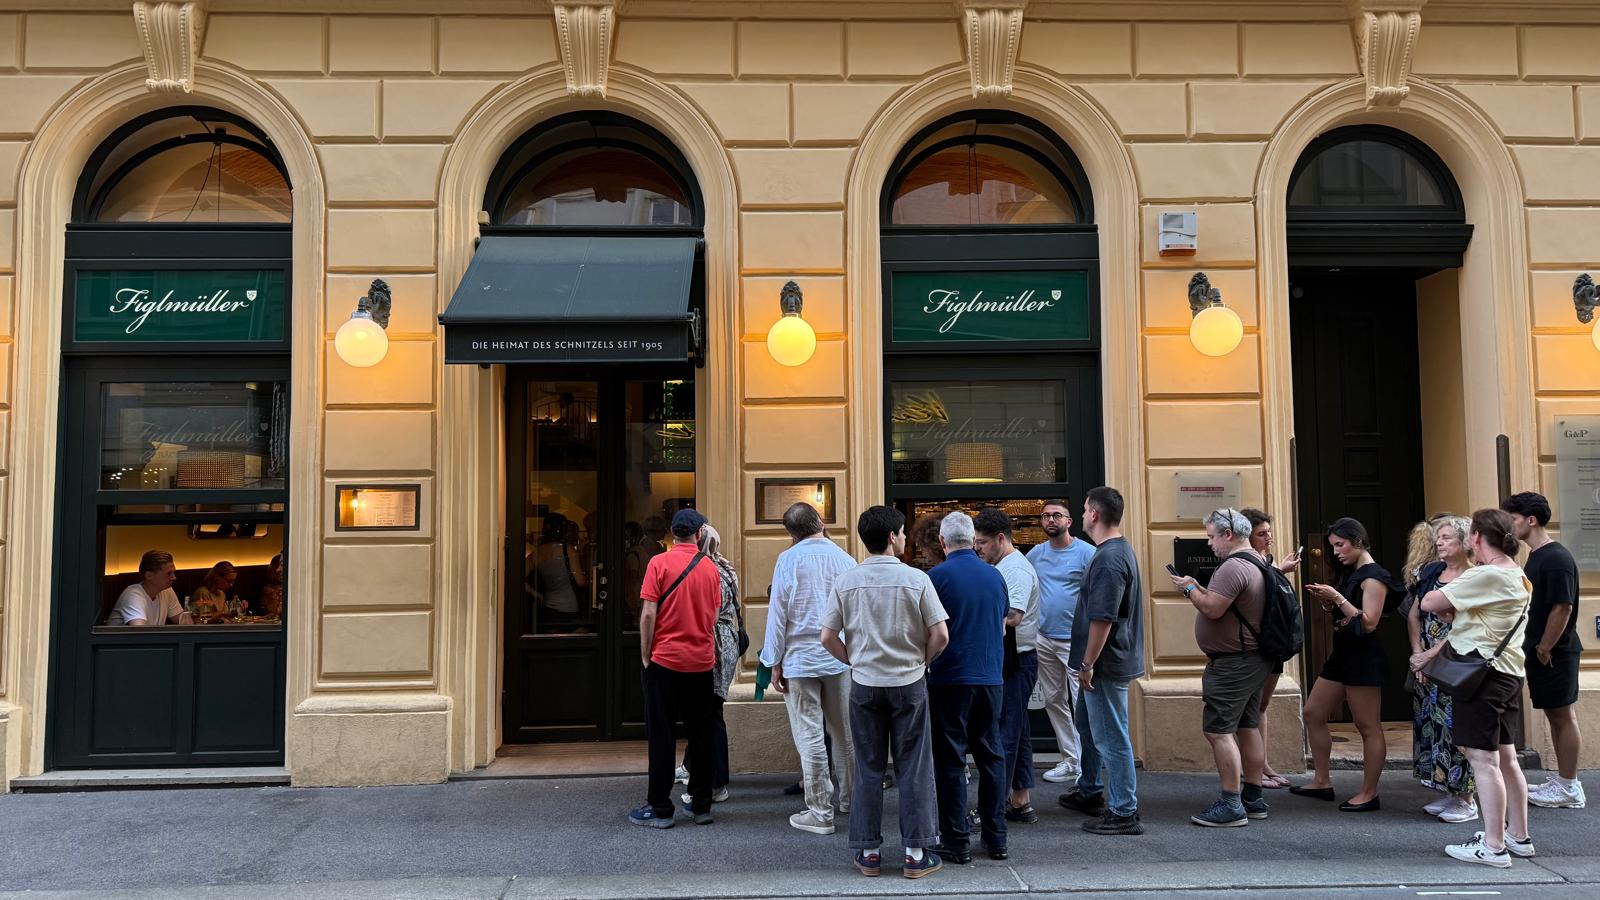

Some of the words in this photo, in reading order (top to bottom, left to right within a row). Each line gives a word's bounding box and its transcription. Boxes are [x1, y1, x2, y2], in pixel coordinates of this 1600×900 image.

[109, 288, 250, 334] Figlmüller
[923, 289, 1055, 334] Figlmüller
[472, 341, 489, 350] DIE
[492, 341, 530, 350] HEIMAT
[533, 341, 551, 349] DES
[554, 340, 614, 349] SCHNITZELS
[617, 340, 638, 349] SEIT
[641, 342, 663, 351] 1905
[1564, 430, 1589, 438] G&P
